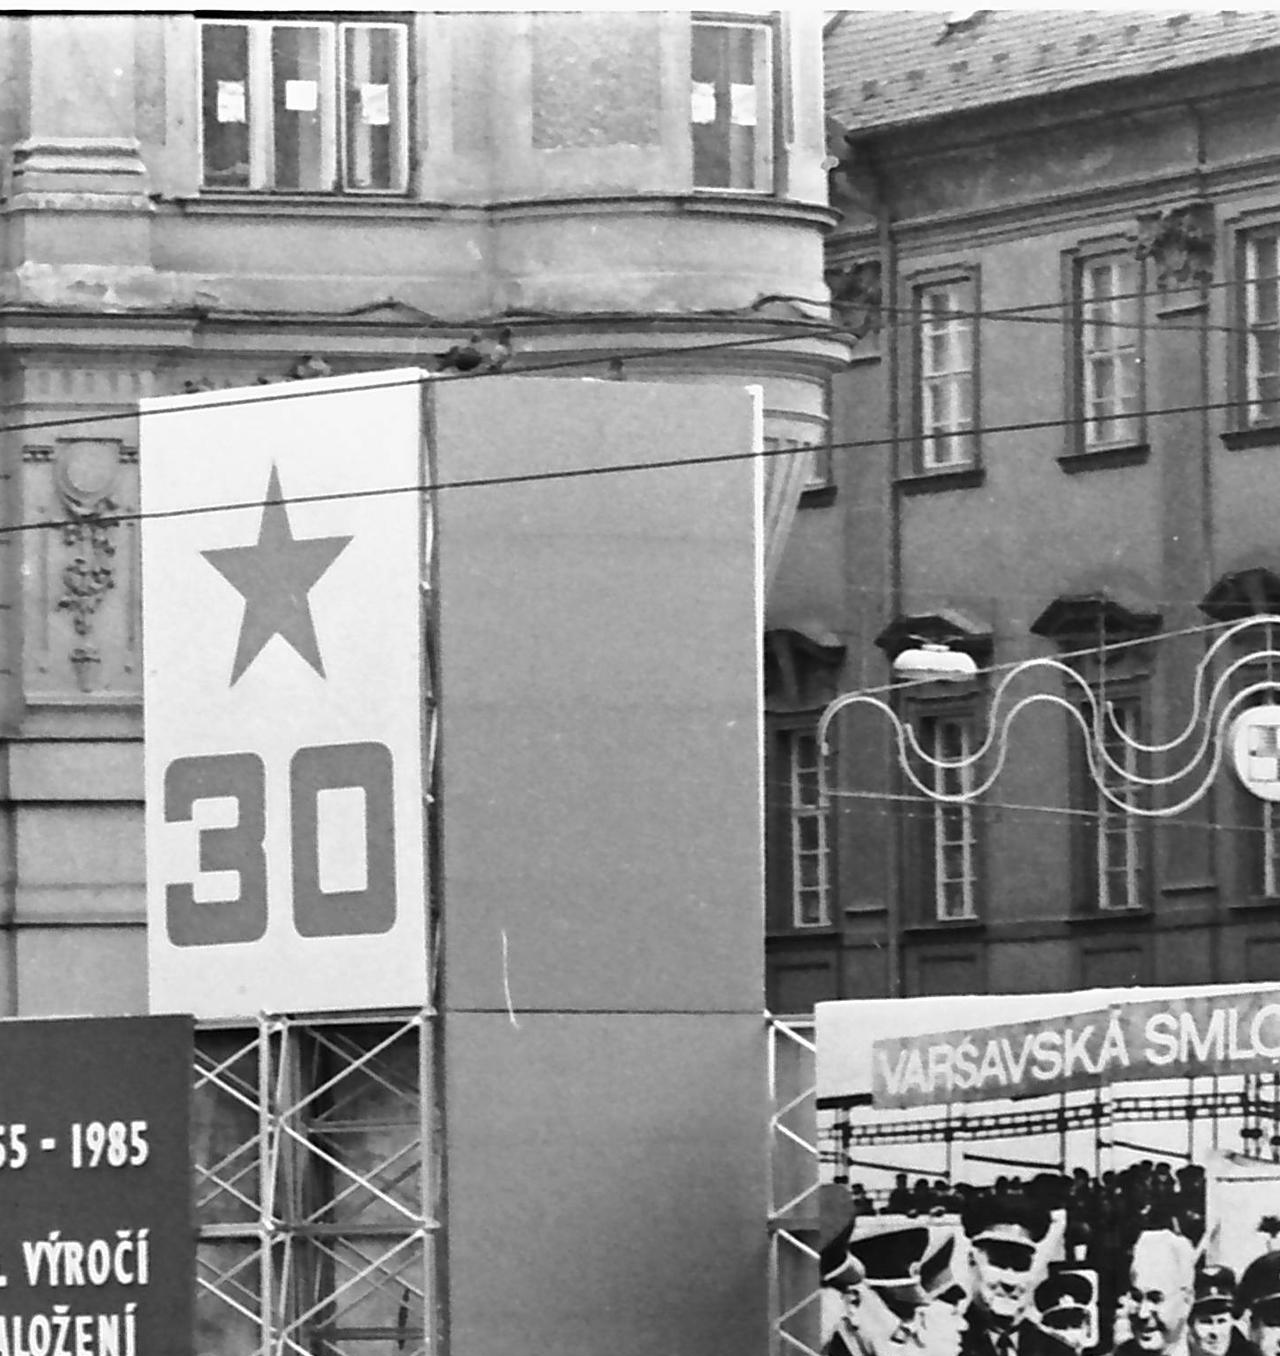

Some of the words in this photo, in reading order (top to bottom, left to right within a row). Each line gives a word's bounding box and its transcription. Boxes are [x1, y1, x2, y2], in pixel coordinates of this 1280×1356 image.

[164, 741, 398, 947] 30
[71, 1120, 149, 1168] 1985
[22, 1228, 149, 1286] VÝROČÍ
